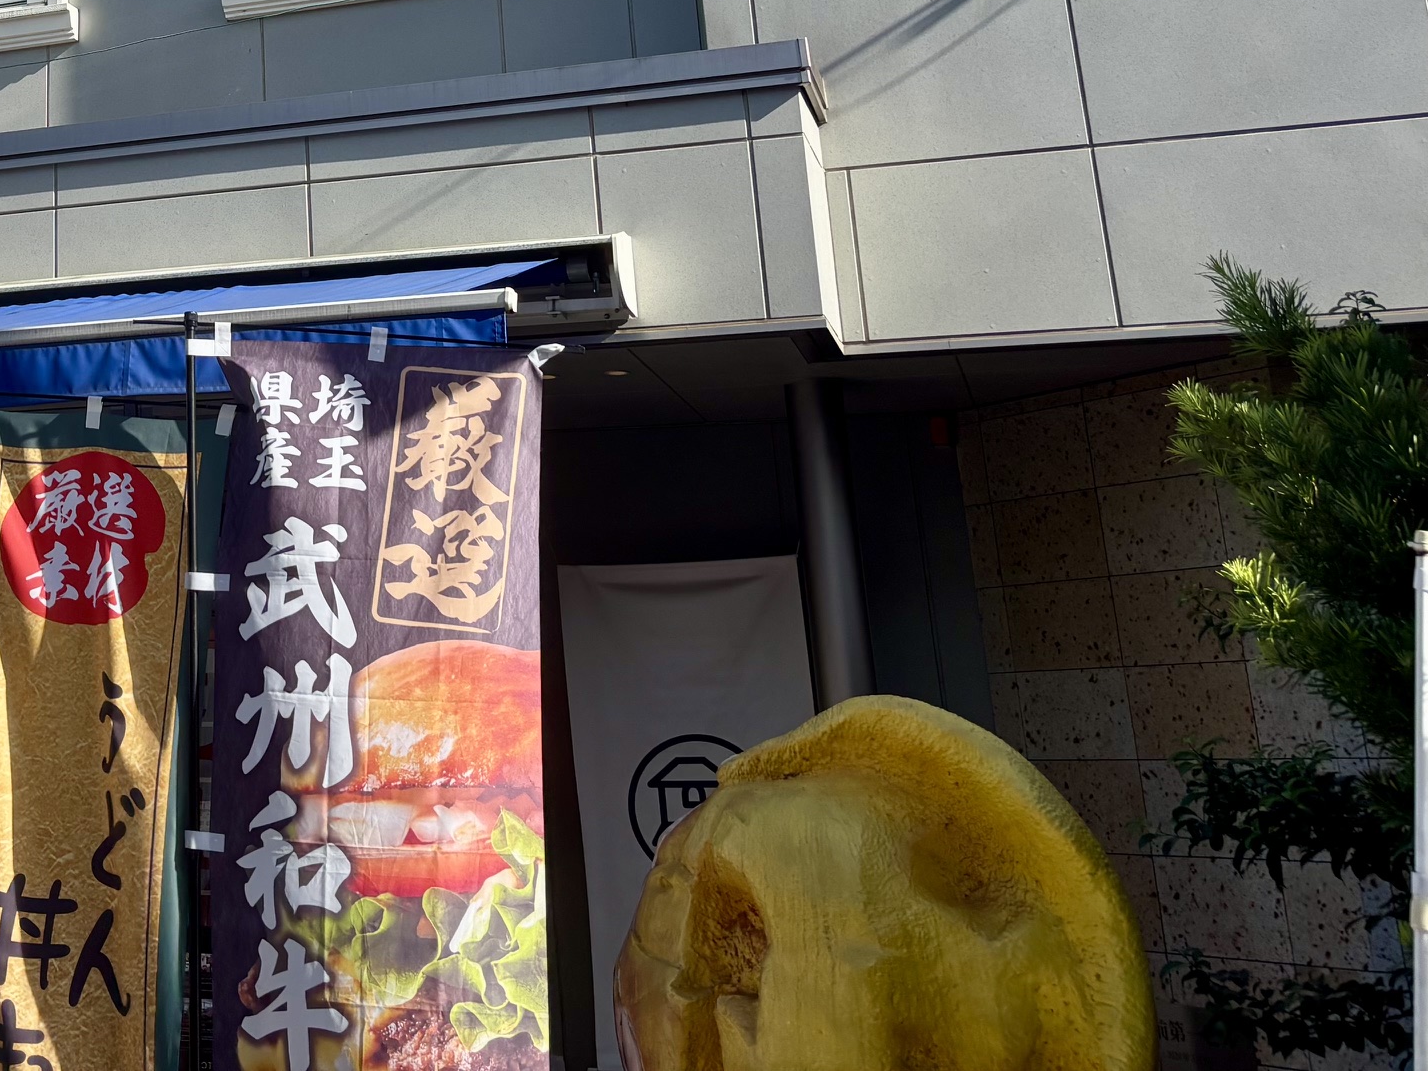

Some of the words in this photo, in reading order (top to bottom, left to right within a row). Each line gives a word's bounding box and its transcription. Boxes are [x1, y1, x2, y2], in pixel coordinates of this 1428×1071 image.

[250, 371, 303, 488] 県産
[309, 374, 371, 491] 埼玉
[69, 670, 145, 1016] うどん
[236, 516, 358, 1071] 武州和牛
